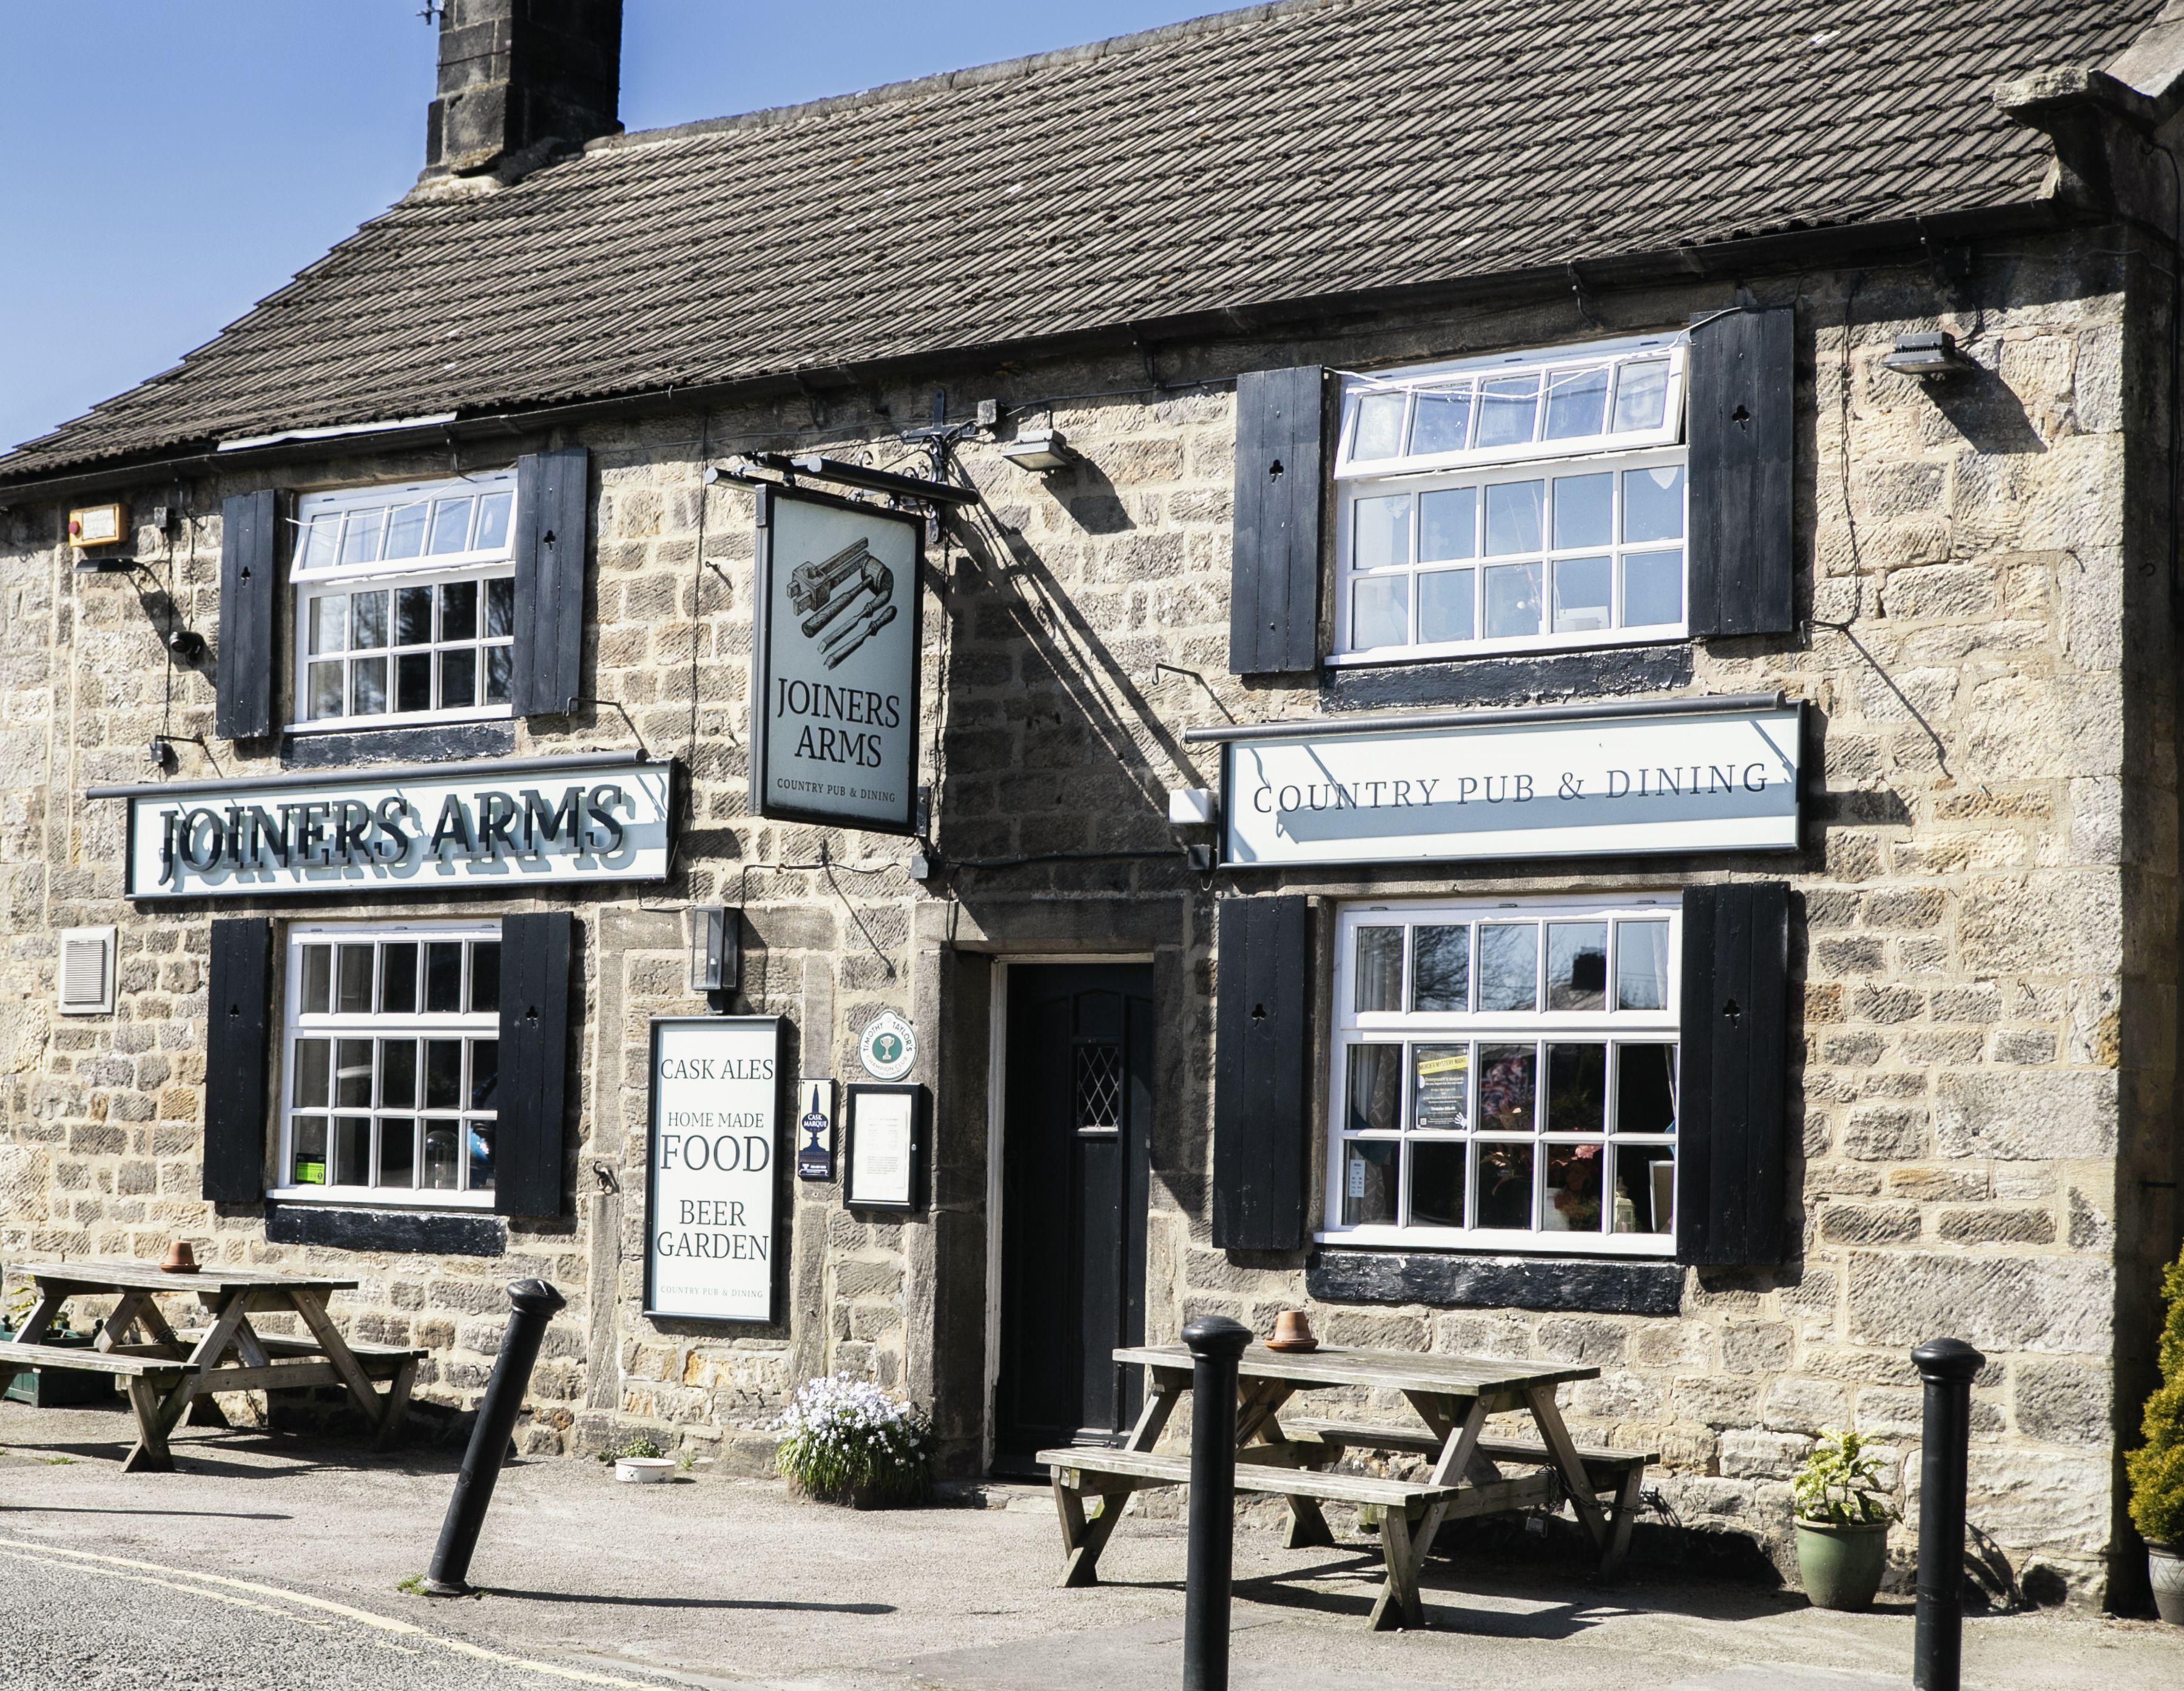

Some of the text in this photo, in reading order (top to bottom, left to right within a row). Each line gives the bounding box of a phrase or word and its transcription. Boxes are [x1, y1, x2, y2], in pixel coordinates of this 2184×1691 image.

[777, 677, 900, 728] JOINERS
[794, 725, 881, 768] ARMS
[777, 778, 895, 802] COUNTRY PUB & DINING
[1253, 763, 1768, 813] COUNTRY PUB & DINING
[158, 784, 624, 886] JOINERS ARMS
[863, 1021, 913, 1052] TIMOTHY TAYLOR'S
[661, 1059, 774, 1080] CASK ALES
[895, 1056, 908, 1069] CLUB
[1436, 1059, 1454, 1067] MYSTERY
[668, 1112, 764, 1128] HOME MADE
[661, 1135, 770, 1172] FOOD
[679, 1200, 746, 1226] BEER
[657, 1231, 769, 1261] GARDEN
[661, 1285, 699, 1295] COUNTRY
[732, 1289, 763, 1299] DINING
